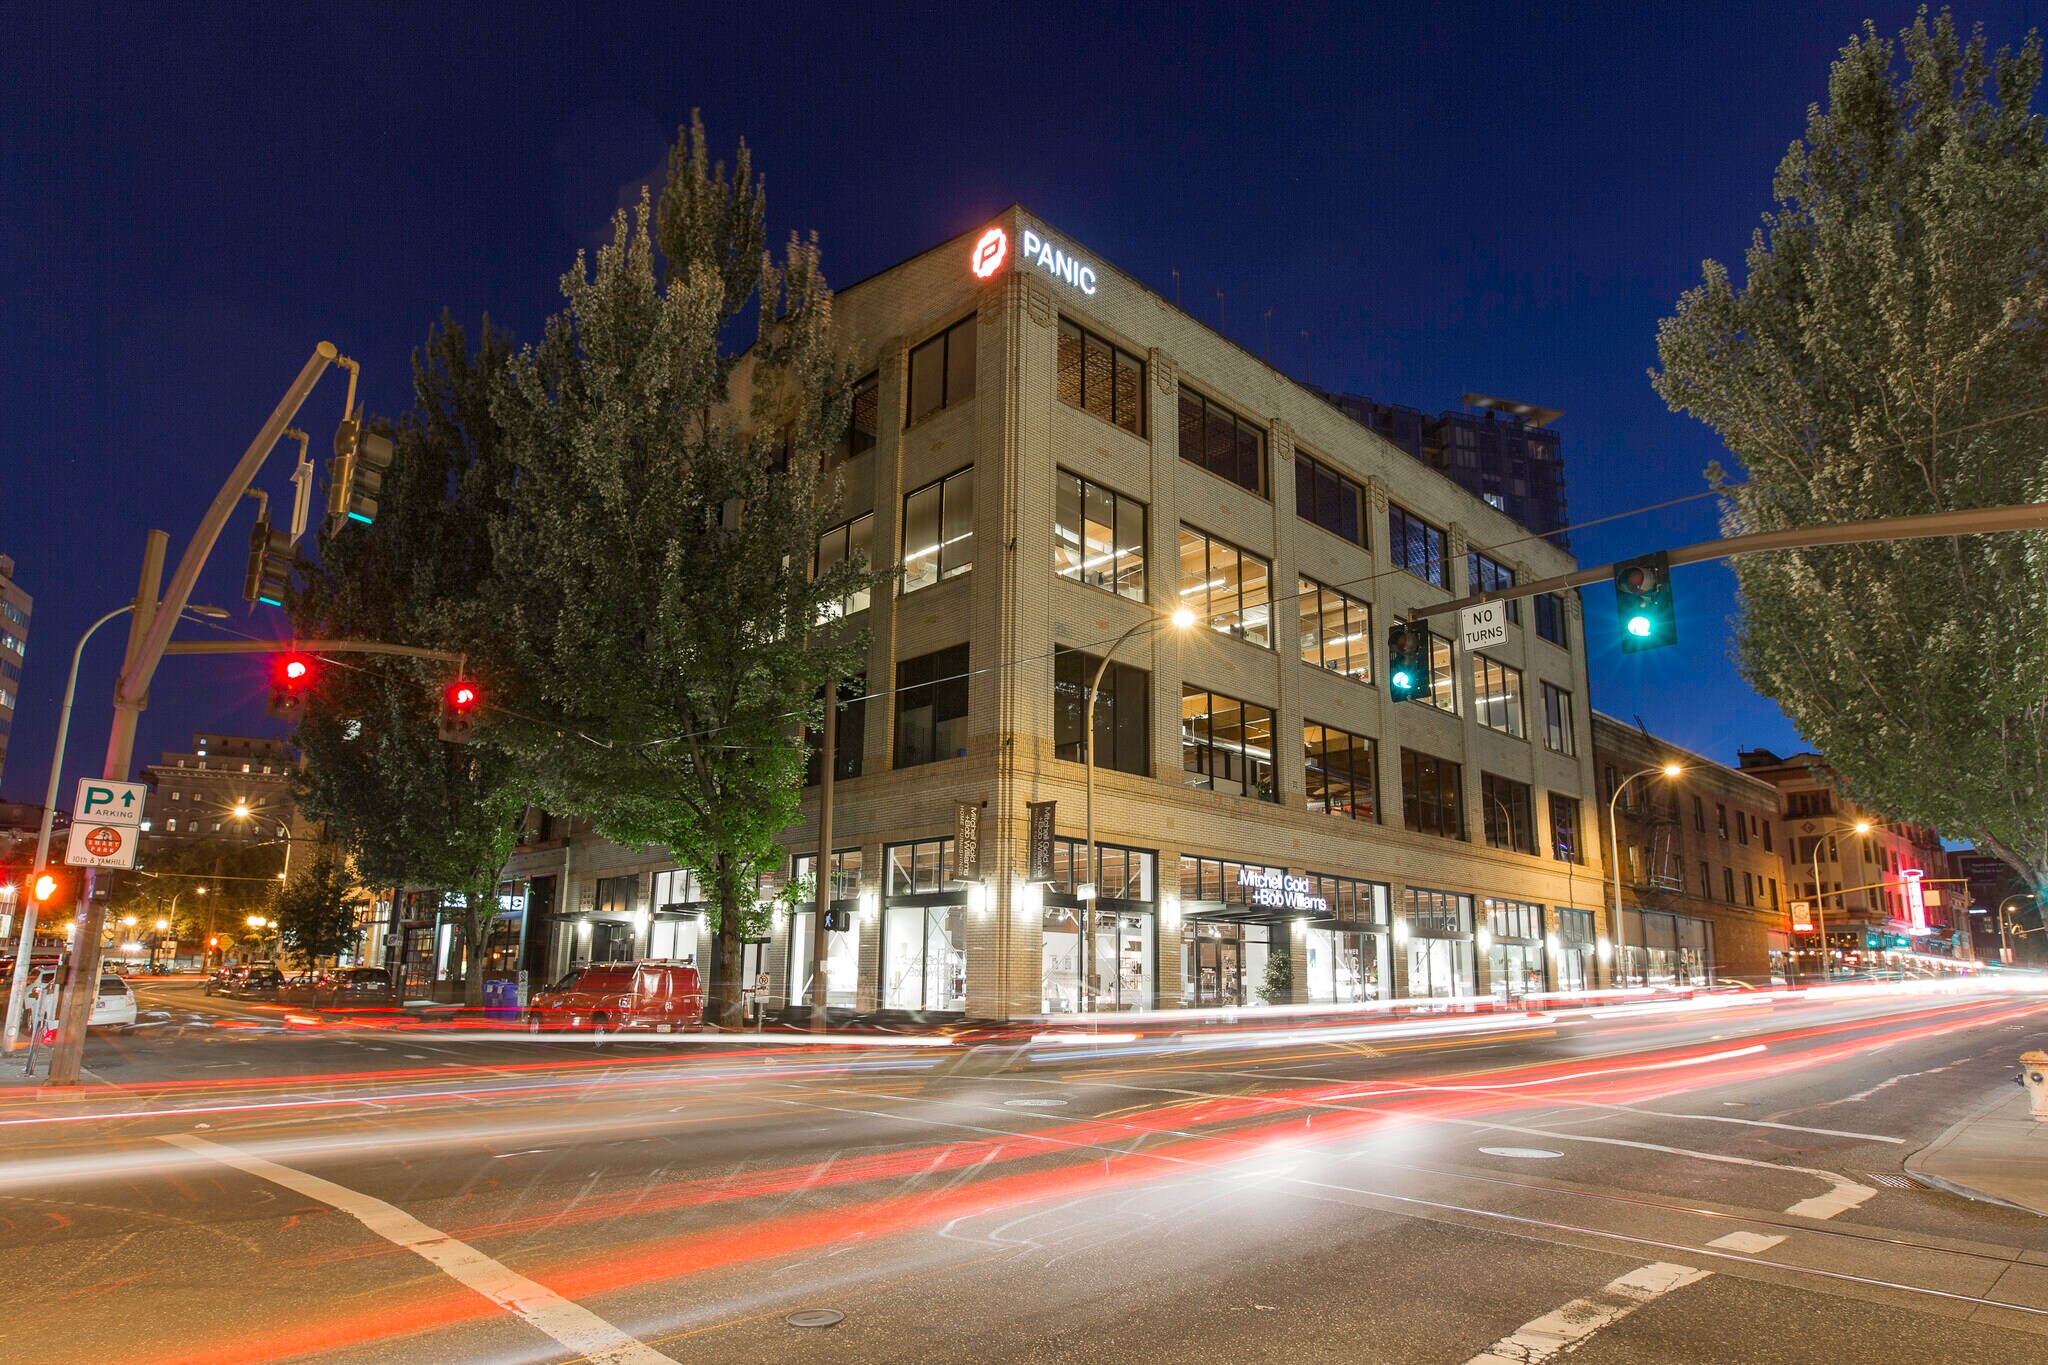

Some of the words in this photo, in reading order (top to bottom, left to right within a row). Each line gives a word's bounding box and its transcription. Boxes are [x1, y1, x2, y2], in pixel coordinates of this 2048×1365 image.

[1023, 229, 1096, 295] PANIC
[1473, 609, 1493, 625] NO
[1466, 626, 1503, 643] TURNS
[1043, 806, 1051, 840] Mitchell
[97, 858, 126, 866] YAMHILL
[963, 840, 971, 876] Williams
[969, 841, 977, 863] Gold
[1239, 869, 1282, 889] Mitchell
[1284, 875, 1309, 892] Gold
[1284, 892, 1327, 911] Williams
